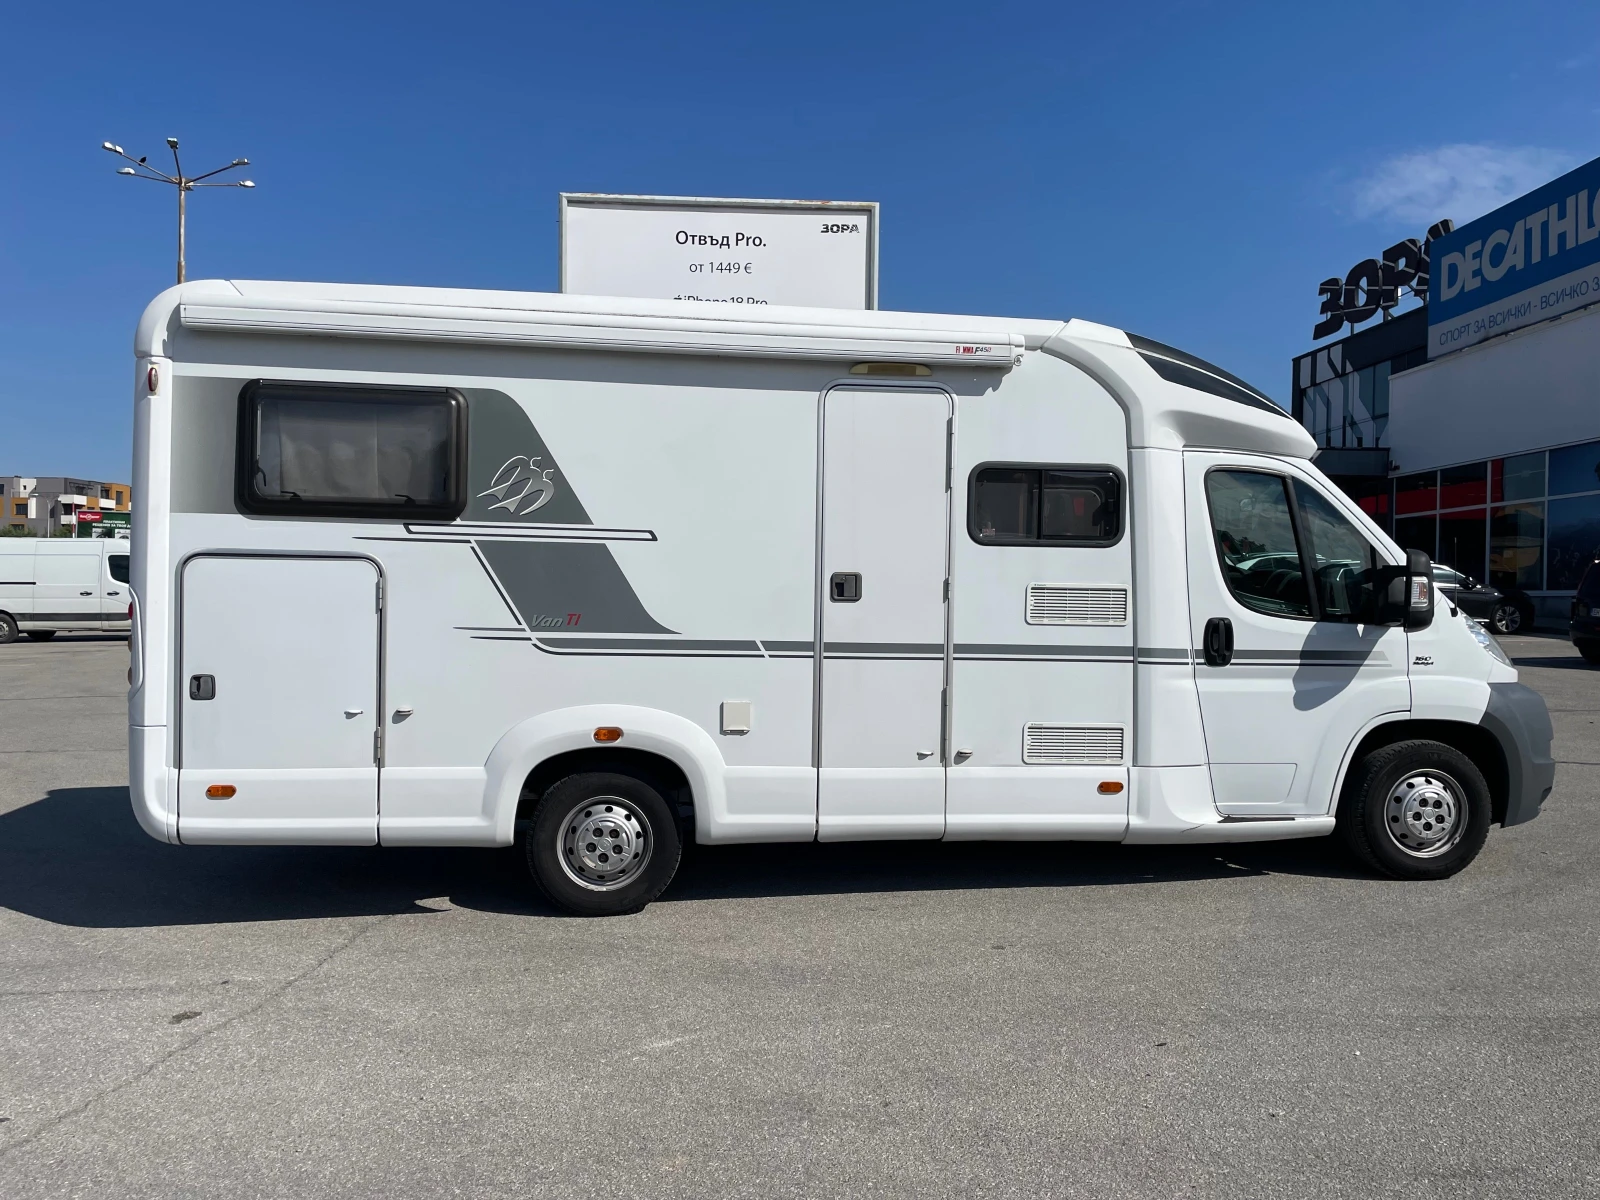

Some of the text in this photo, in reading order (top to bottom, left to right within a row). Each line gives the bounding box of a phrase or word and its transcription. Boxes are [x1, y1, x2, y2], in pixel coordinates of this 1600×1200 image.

[820, 223, 860, 233] ЗОРА
[675, 230, 766, 249] Отвъд Pro.
[1440, 187, 1600, 302] DECATHL
[689, 261, 752, 274] от 1449 €
[1440, 322, 1472, 346] СПОРТ
[1473, 318, 1487, 334] ЗА
[1488, 301, 1531, 329] ВСИЧКИ
[1540, 280, 1589, 310] ВСИЧКО
[531, 614, 563, 628] Van
